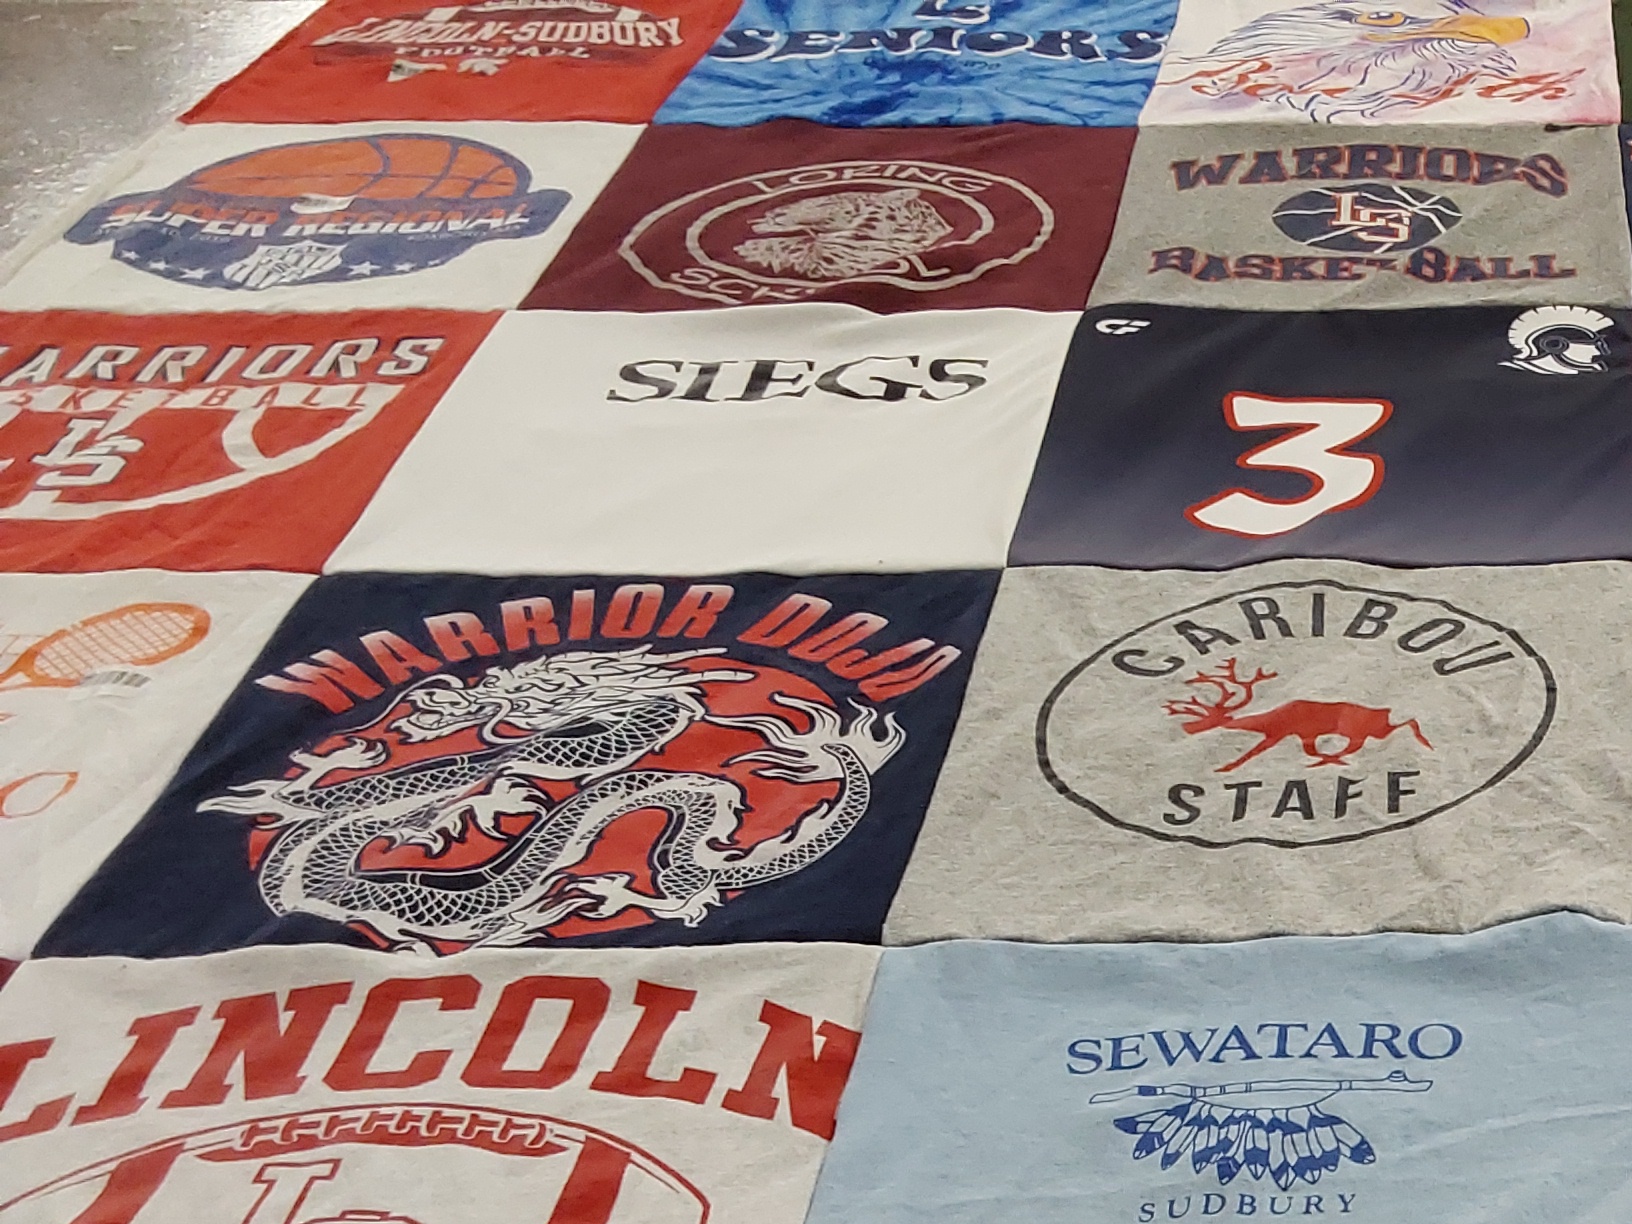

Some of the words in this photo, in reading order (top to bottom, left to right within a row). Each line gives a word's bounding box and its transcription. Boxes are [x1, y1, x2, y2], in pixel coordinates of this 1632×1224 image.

[311, 17, 684, 47] LINCOLN-SUDBURY
[707, 28, 1169, 62] SENIORS
[752, 164, 992, 194] LORING
[1170, 143, 1570, 197] WARRIORS
[100, 200, 280, 238] SUPER
[282, 203, 531, 236] REGIONAL
[0, 337, 445, 386] ARRIORS
[606, 355, 990, 402] SIEGS
[1183, 390, 1394, 540] 3
[255, 583, 735, 715] WARRIOR
[737, 592, 963, 703] DOJO
[1112, 592, 1515, 678] CARIBOU
[1162, 769, 1424, 826] STAFF
[0, 974, 863, 1144] LINCOLN
[1066, 1022, 1464, 1075] SEWATARO
[1138, 1192, 1357, 1224] SUDBURY
